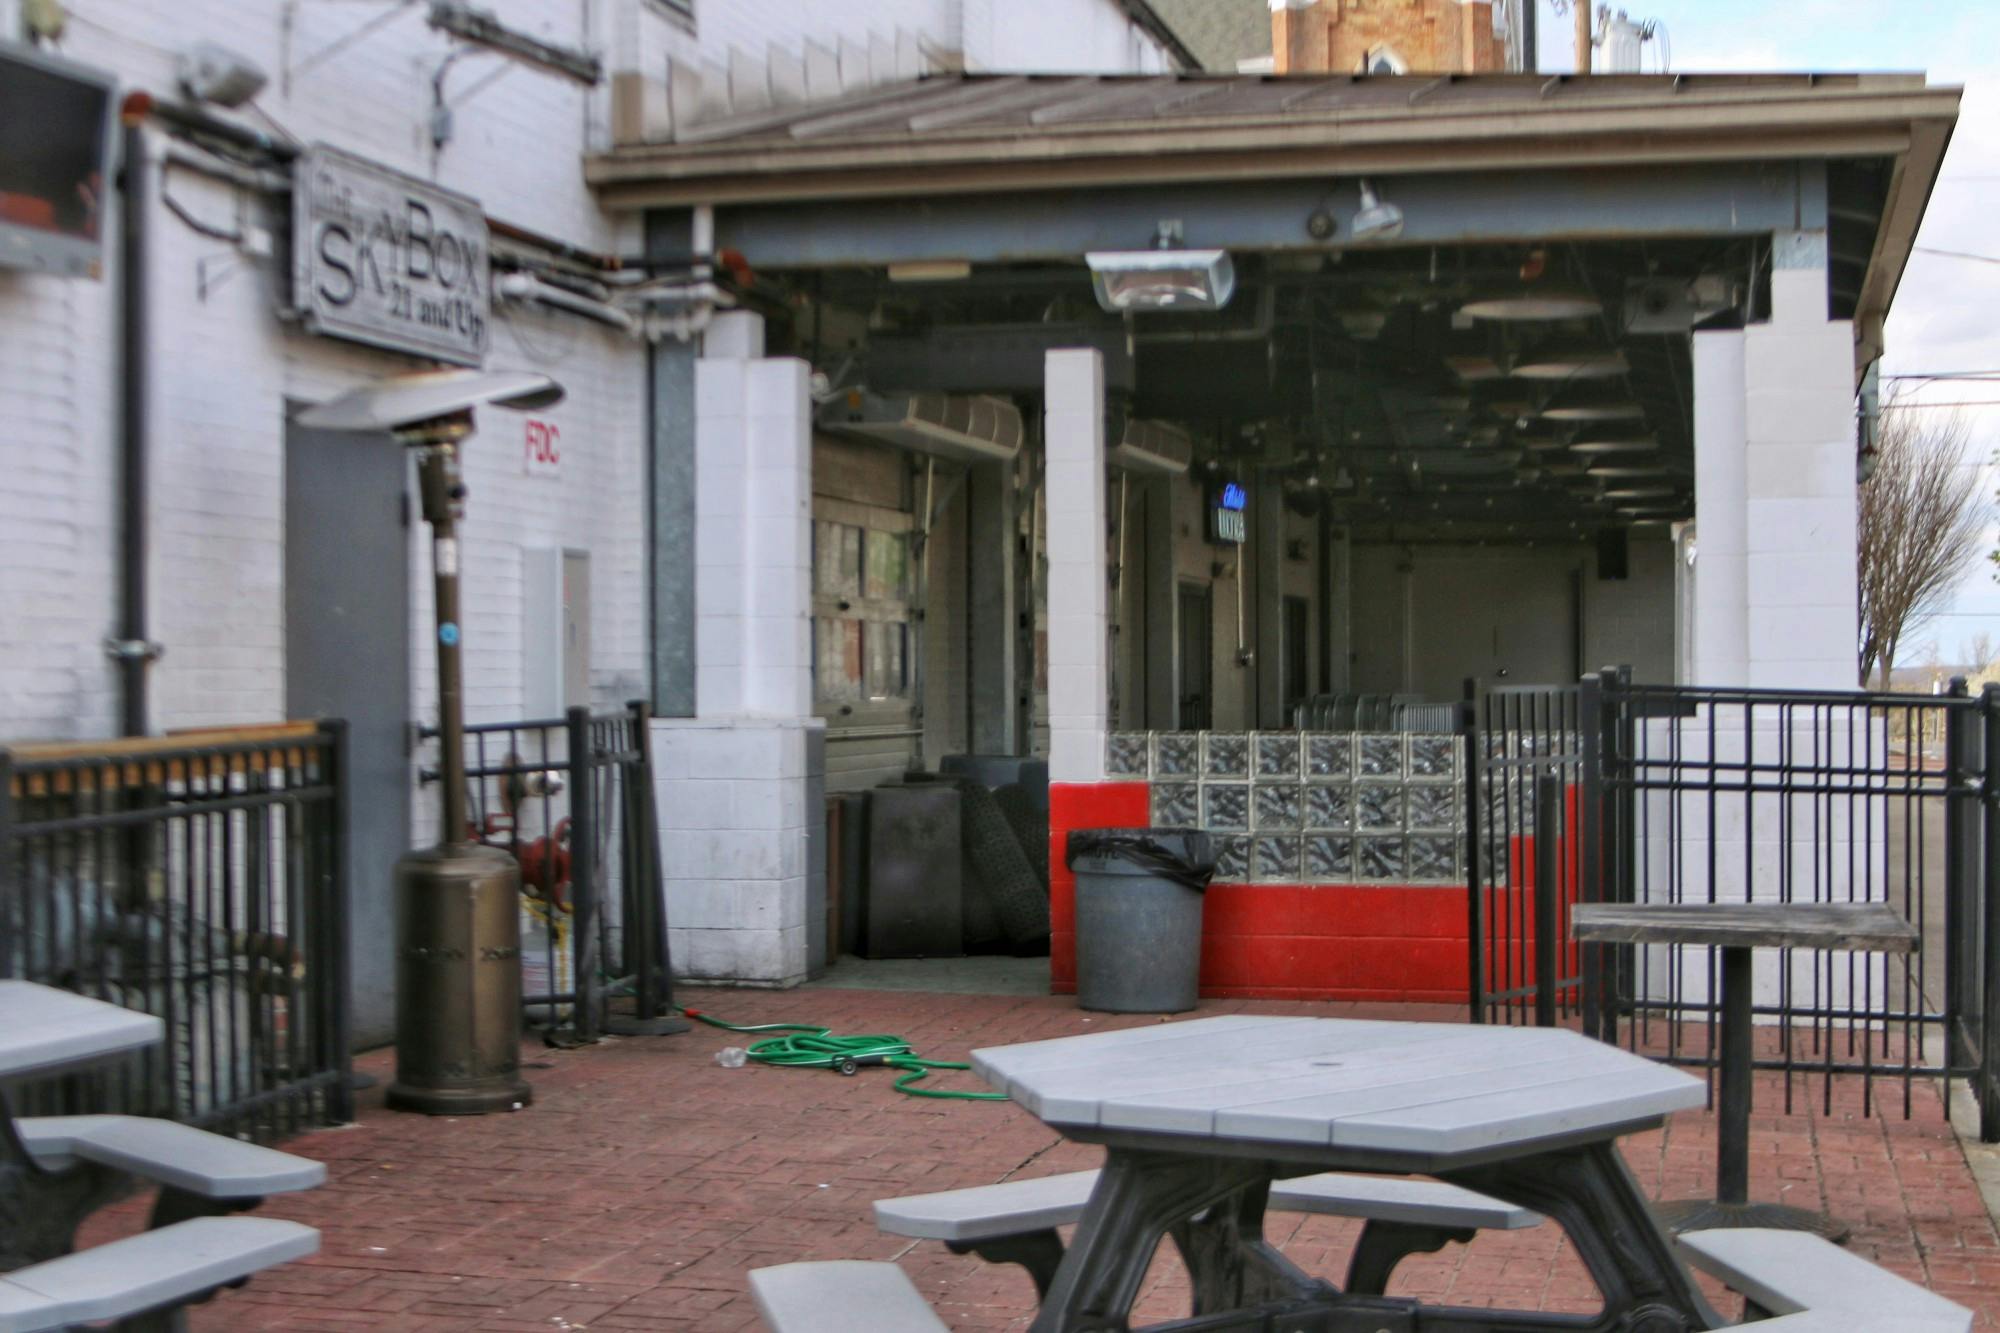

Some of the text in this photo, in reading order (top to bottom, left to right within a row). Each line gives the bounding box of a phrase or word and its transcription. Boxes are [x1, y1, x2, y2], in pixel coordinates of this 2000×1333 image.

[391, 280, 485, 347] 21 and Up
[525, 419, 561, 465] FDC
